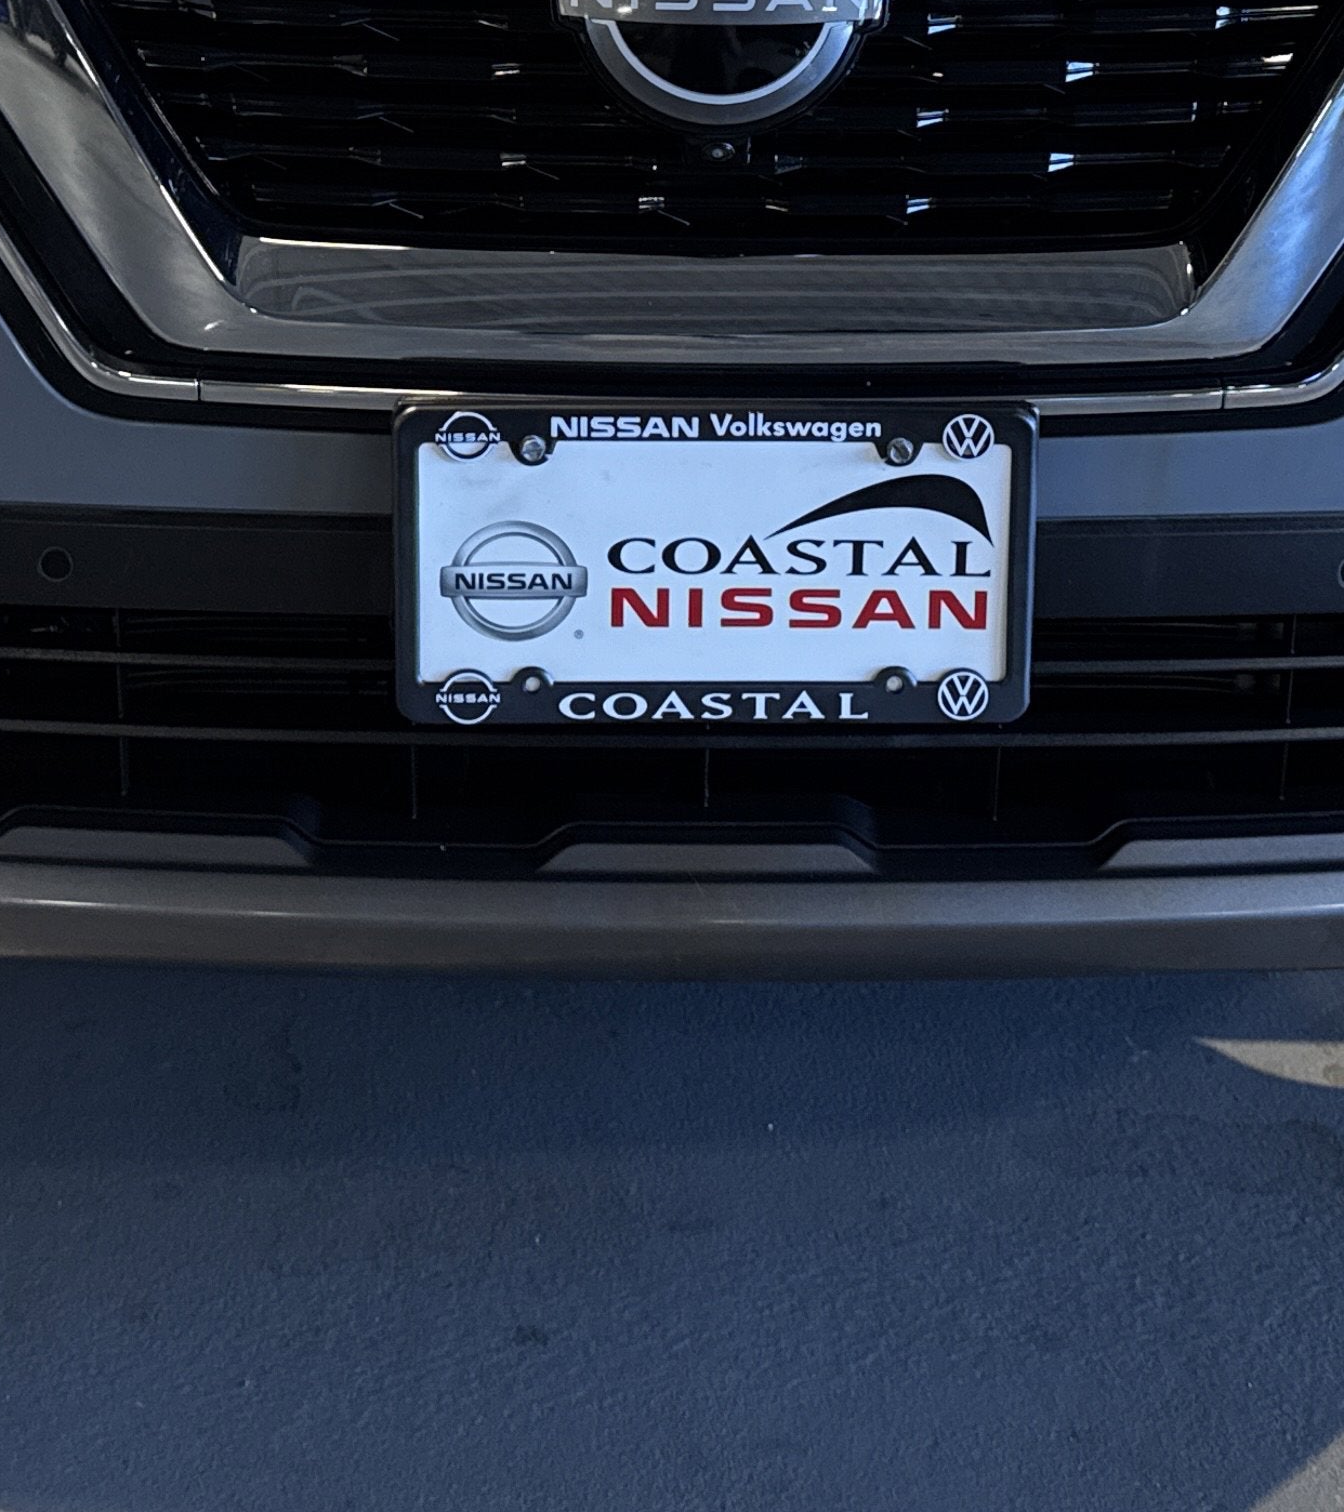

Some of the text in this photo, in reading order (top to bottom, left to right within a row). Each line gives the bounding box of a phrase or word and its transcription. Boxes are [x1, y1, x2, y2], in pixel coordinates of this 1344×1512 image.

[435, 431, 501, 443] NISSAN
[550, 411, 882, 442] NISSAN Volkswagen
[606, 535, 993, 578] COASTAL
[455, 571, 574, 592] NISSAN
[610, 587, 988, 630] NISSAN
[435, 692, 501, 704] NISSAN
[558, 690, 870, 720] COASTAL
